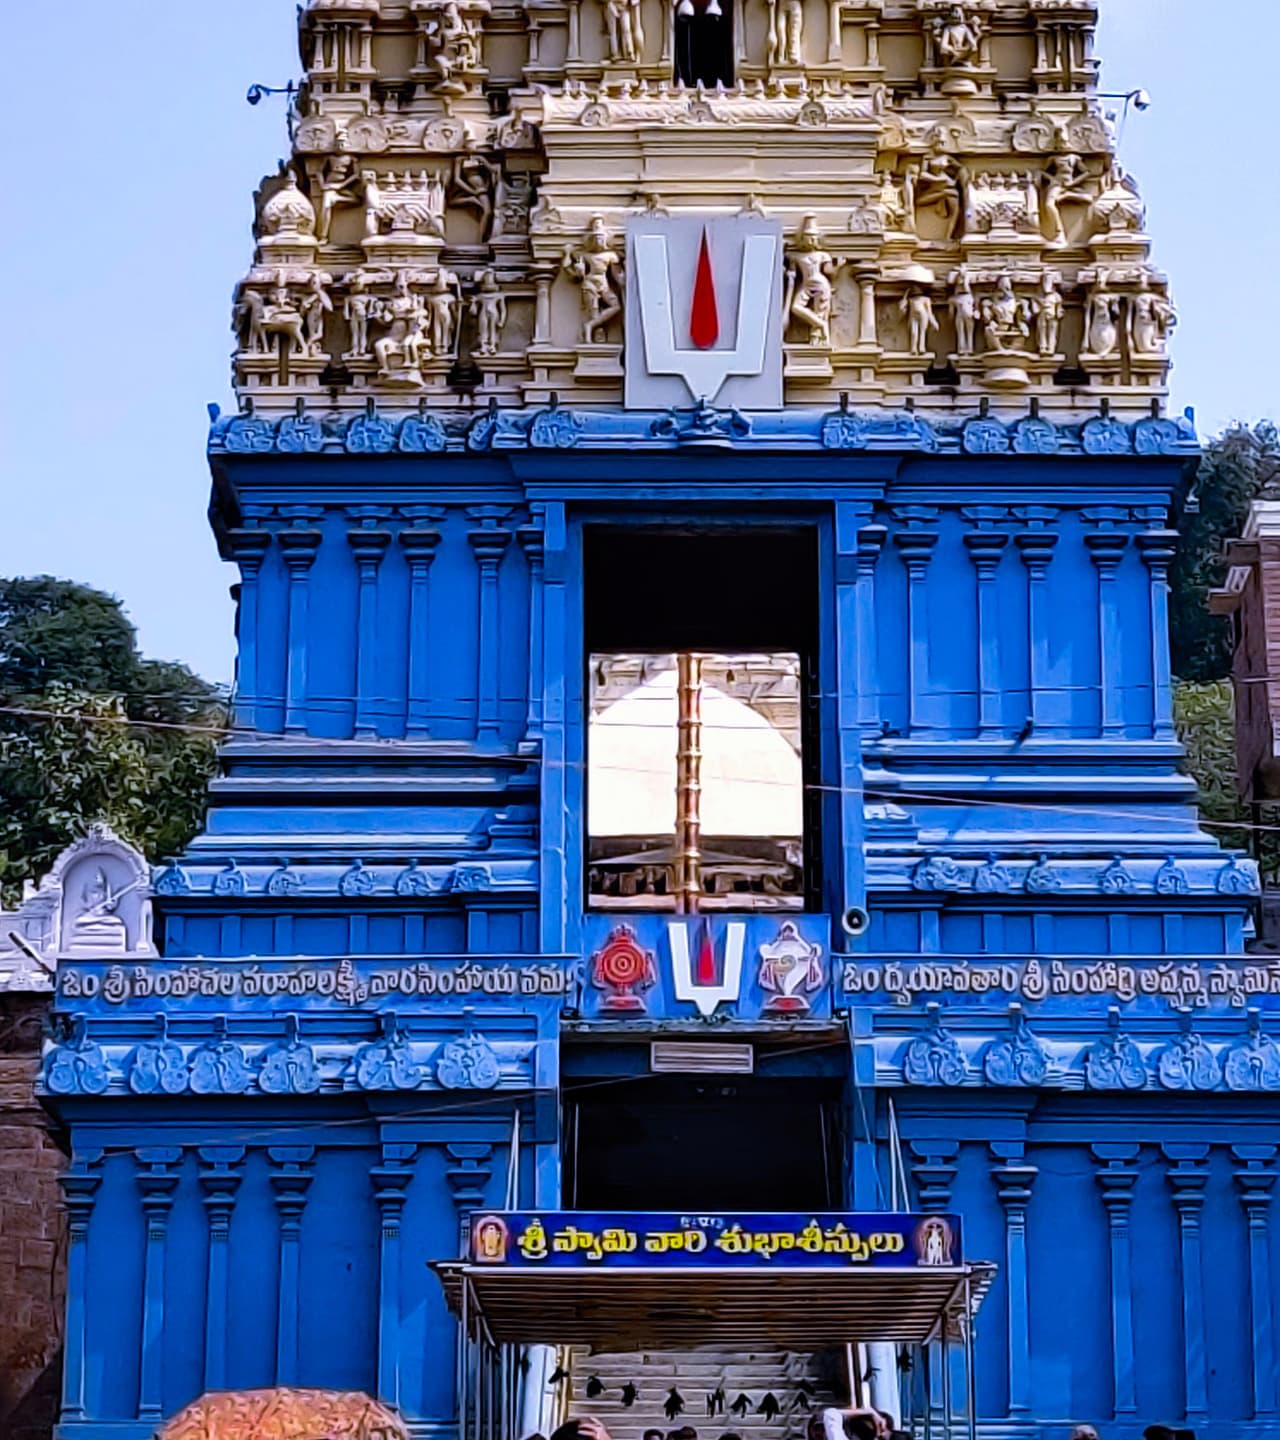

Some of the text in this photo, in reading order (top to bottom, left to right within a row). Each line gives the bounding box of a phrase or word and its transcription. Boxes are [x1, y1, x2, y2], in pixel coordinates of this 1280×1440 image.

[63, 968, 99, 996] ఓం
[104, 964, 130, 1003] శ్రీ
[843, 963, 880, 993] ఓం
[1022, 960, 1048, 1000] శ్రీ
[517, 1218, 549, 1260] శ్రీ
[553, 1225, 638, 1261] స్వామి
[644, 1228, 708, 1253] వారి
